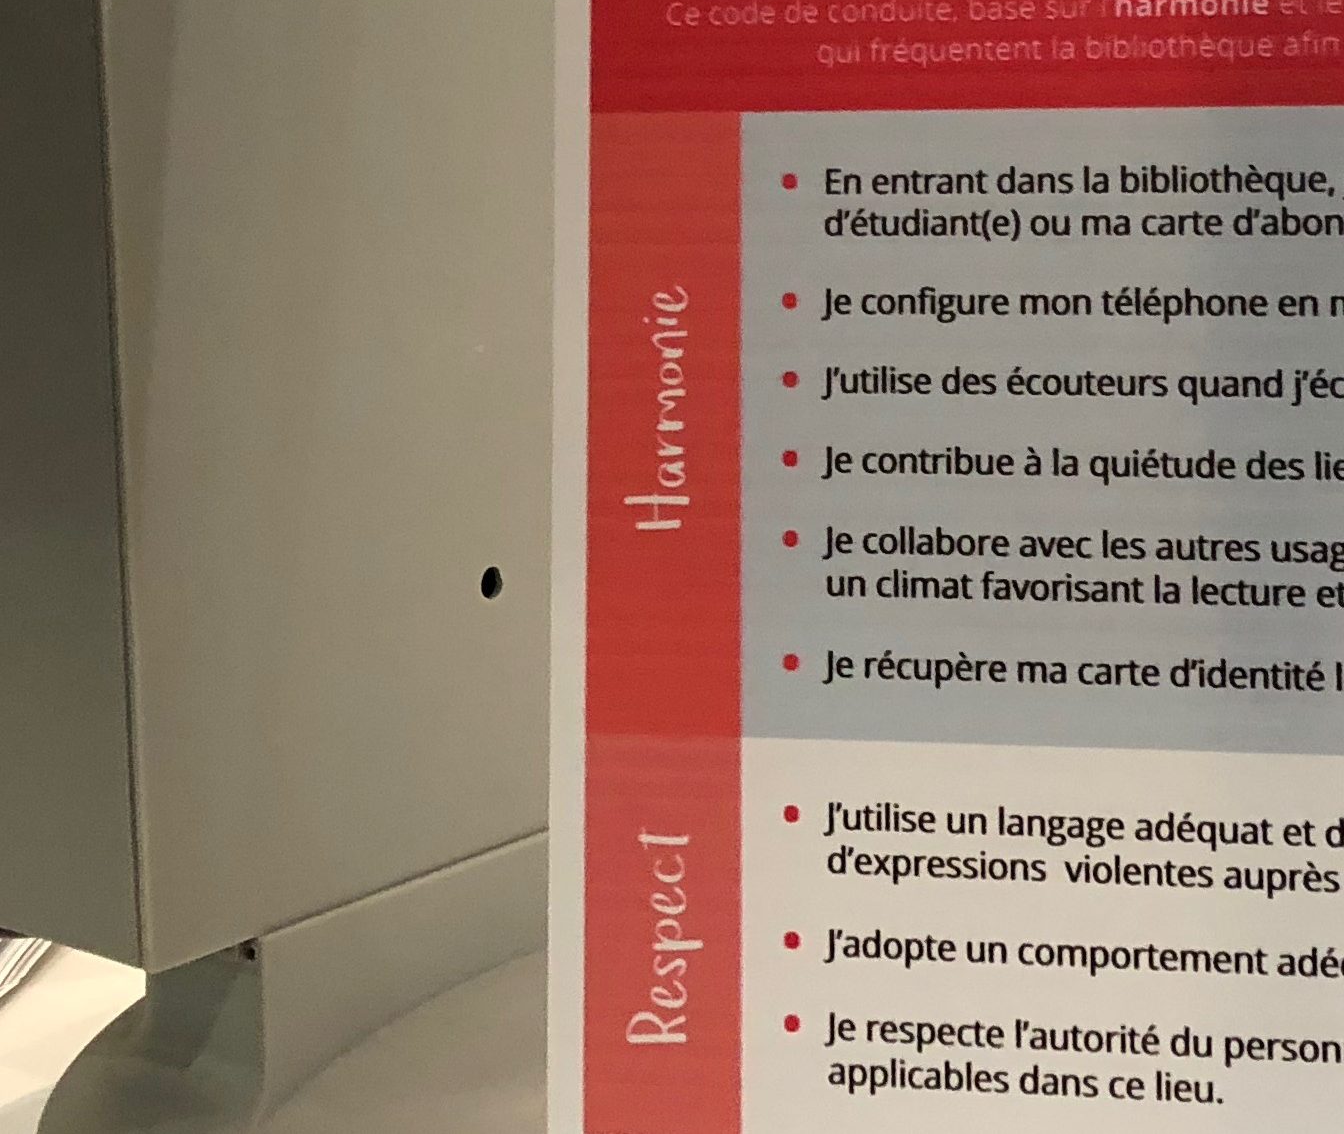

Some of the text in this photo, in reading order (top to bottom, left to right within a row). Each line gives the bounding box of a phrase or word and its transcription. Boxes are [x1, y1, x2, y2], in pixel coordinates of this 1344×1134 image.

[665, 1, 701, 27] Ce
[708, 2, 776, 26] code
[784, 0, 819, 25] de
[1045, 0, 1091, 21] sur
[817, 43, 861, 68] qui
[869, 37, 1043, 68] fréquentent
[1051, 38, 1076, 61] la
[1085, 33, 1275, 62] bibliothèque
[1283, 29, 1340, 57] afin
[823, 166, 864, 197] En
[870, 168, 990, 197] entrant
[994, 164, 1076, 196] dans
[1081, 163, 1111, 196] la
[1118, 162, 1337, 203] bibliothèque,
[822, 206, 1023, 244] d'étudiant(e)
[1028, 213, 1073, 238] ou
[1080, 213, 1133, 238] ma
[1139, 209, 1225, 238] carte
[819, 364, 934, 402] J'utilise
[940, 364, 999, 397] des
[1005, 364, 1170, 399] écouteurs
[1176, 367, 1285, 407] quand
[623, 284, 691, 531] Harmonie
[820, 524, 855, 562] Je
[860, 524, 1012, 559] collabore
[1017, 534, 1094, 561] avec
[1100, 527, 1148, 562] les
[1153, 533, 1263, 564] autres
[824, 573, 868, 599] un
[874, 567, 975, 602] climat
[979, 568, 1146, 606] favorisant
[1152, 572, 1183, 606] la
[1190, 573, 1308, 609] lecture
[821, 800, 938, 839] J'utilise
[944, 810, 989, 837] un
[996, 804, 1127, 850] langage
[1132, 809, 1275, 854] adéquat
[1281, 818, 1318, 849] et
[825, 842, 1049, 887] d'expressions
[1062, 852, 1216, 890] violentes
[1221, 859, 1343, 901] auprès
[625, 827, 704, 1044] Respect
[822, 1010, 858, 1049] Je
[864, 1018, 1007, 1056] respecte
[1013, 1017, 1162, 1058] l'autorité
[1168, 1024, 1215, 1060] du
[826, 1056, 1225, 1106] applicables dans ce lieu.
